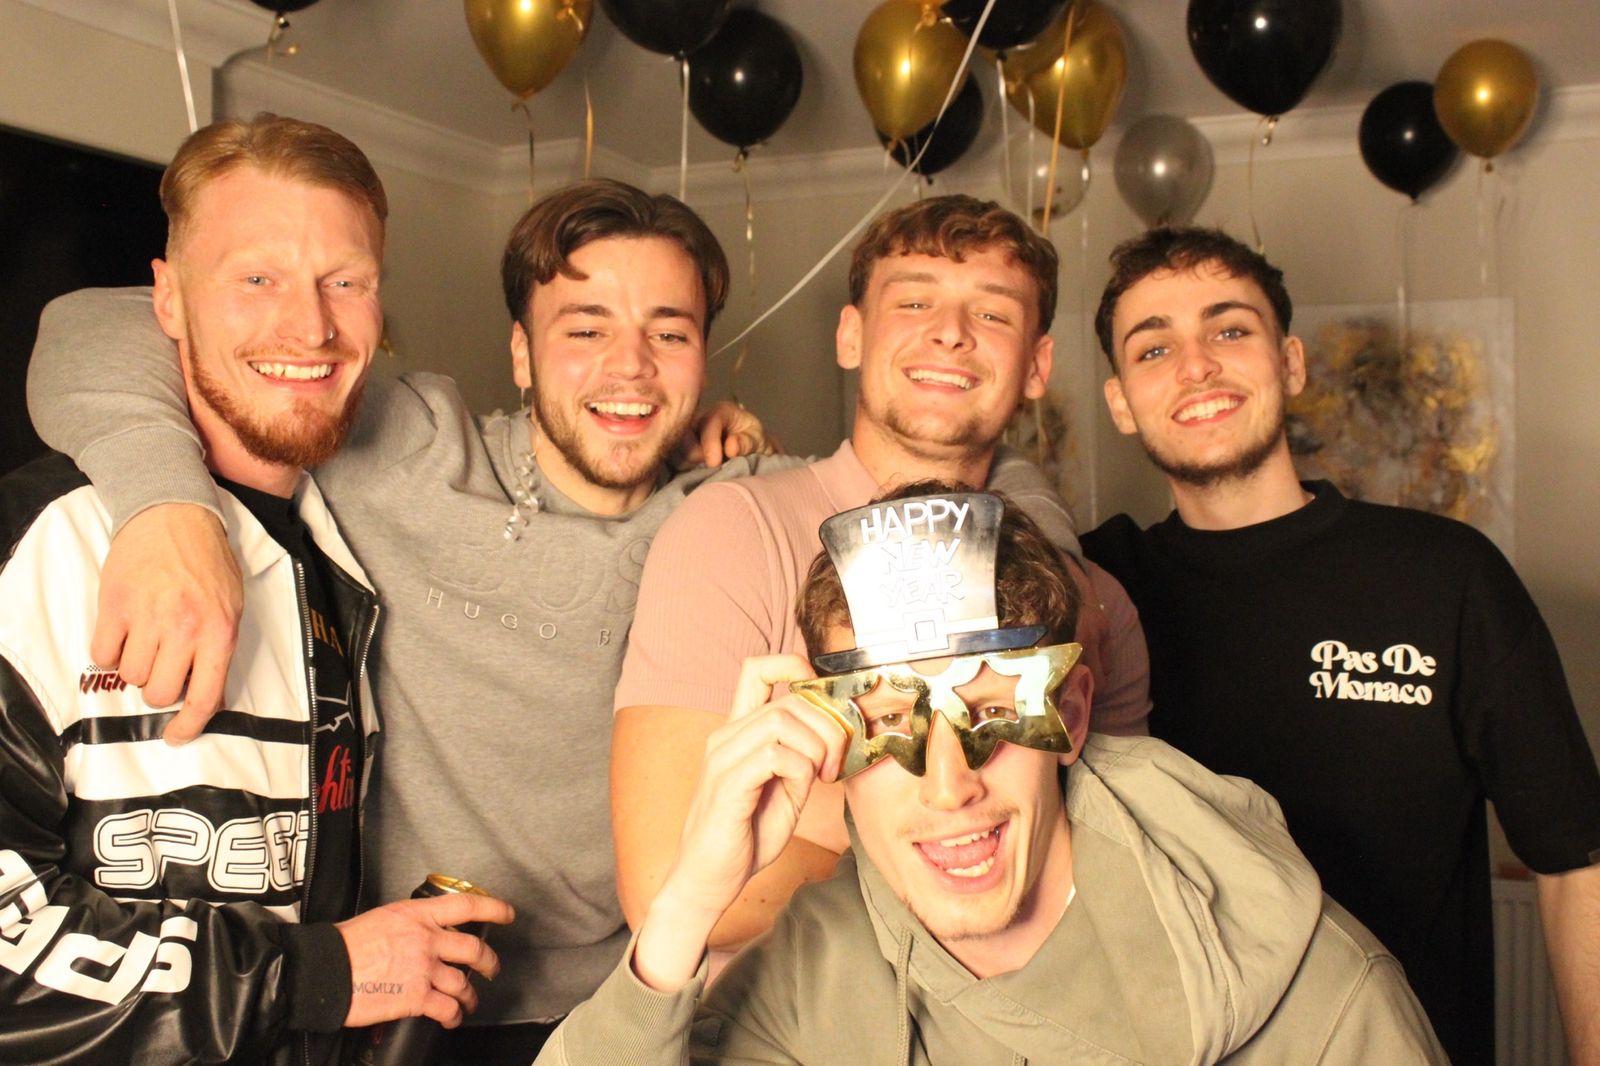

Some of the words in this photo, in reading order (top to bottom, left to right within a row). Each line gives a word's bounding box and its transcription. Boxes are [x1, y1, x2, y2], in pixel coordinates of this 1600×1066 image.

[860, 499, 969, 545] HAPPY
[880, 537, 961, 575] NEW
[879, 570, 967, 608] YEAR
[426, 586, 557, 640] HUGO
[1310, 640, 1379, 674] Pas
[1382, 643, 1437, 676] De
[1308, 671, 1433, 706] Monaco
